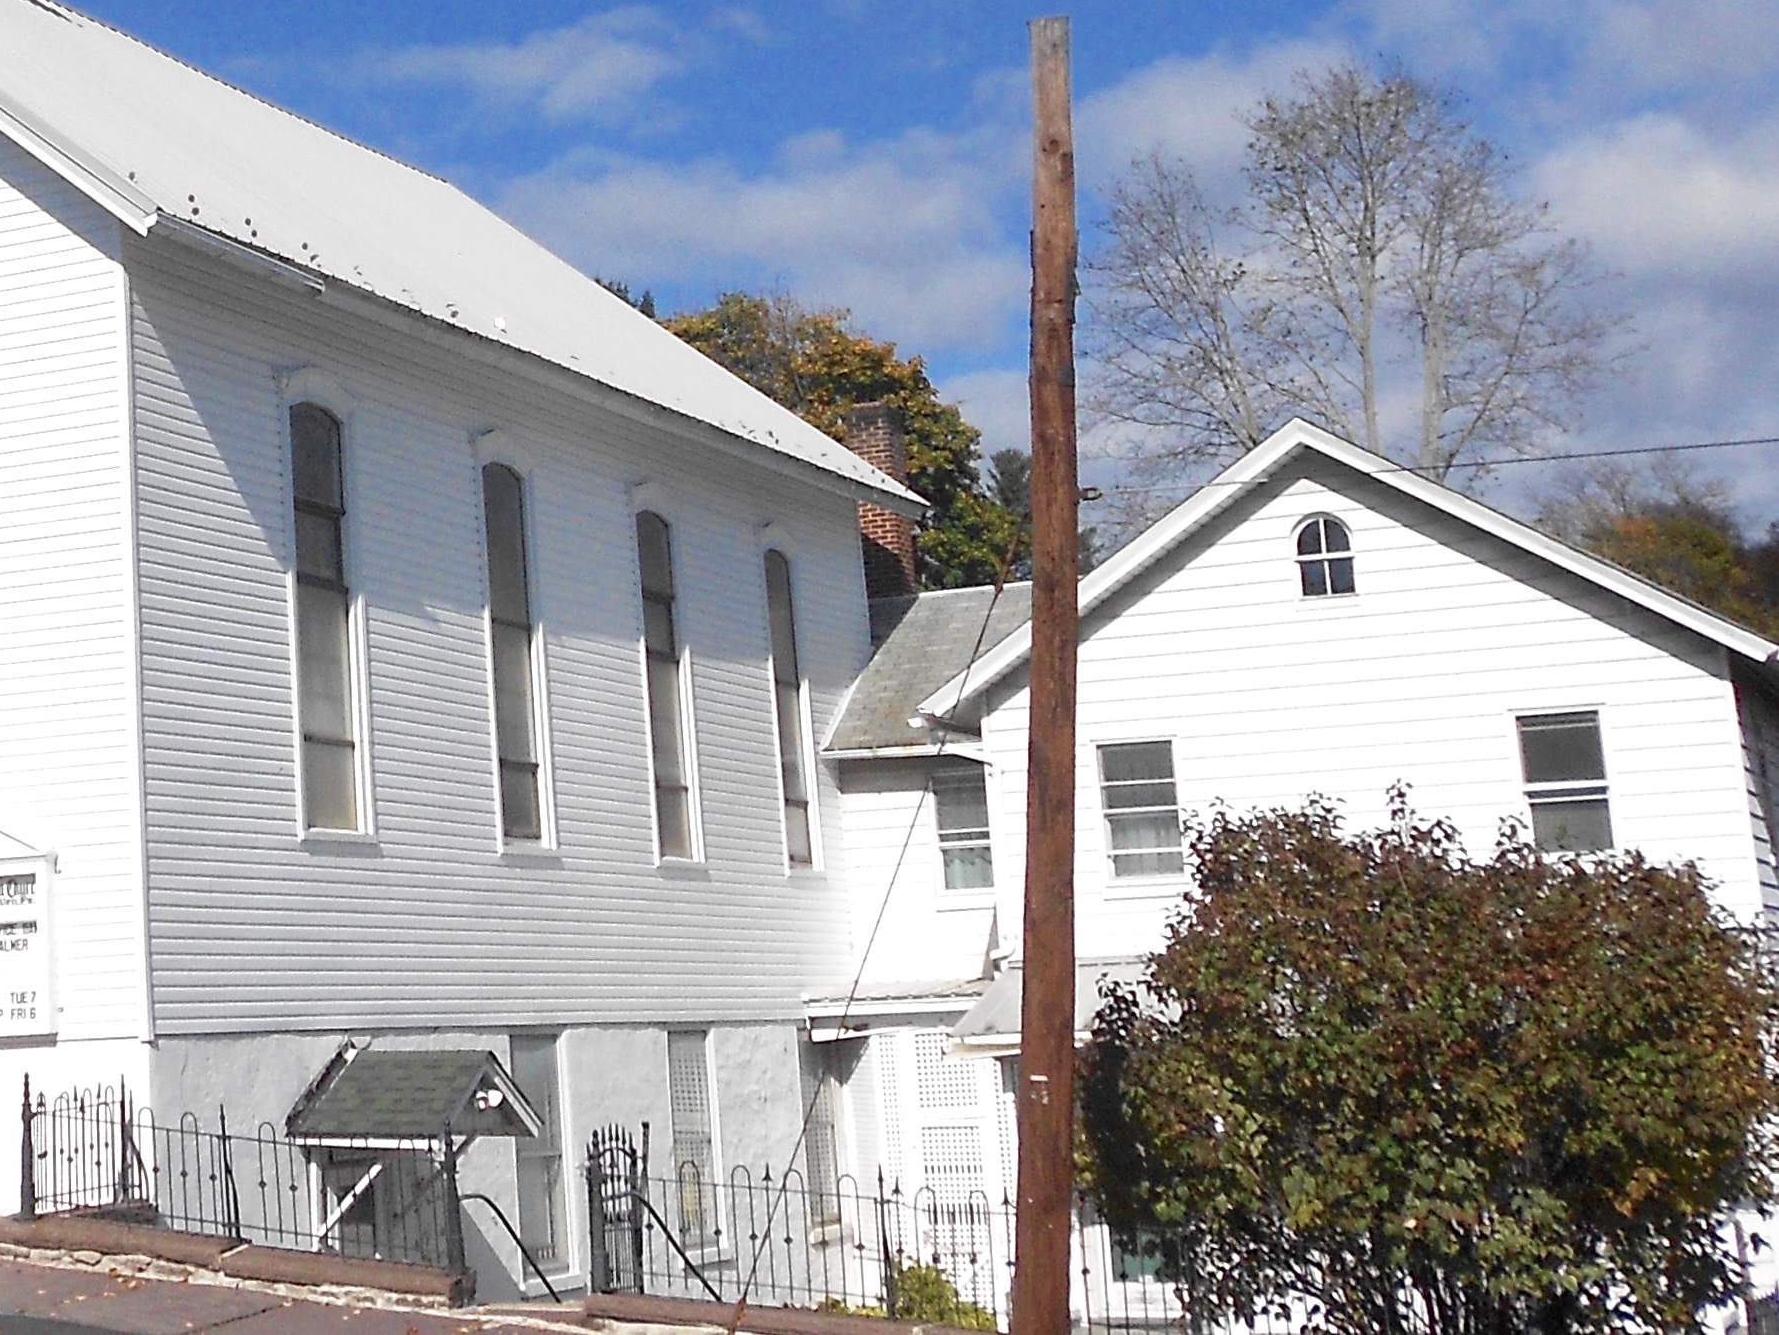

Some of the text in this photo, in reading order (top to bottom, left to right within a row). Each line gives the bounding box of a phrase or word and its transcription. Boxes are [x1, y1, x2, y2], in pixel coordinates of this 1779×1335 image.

[10, 991, 36, 1004] TUE 7
[10, 1007, 36, 1020] FRI 6
